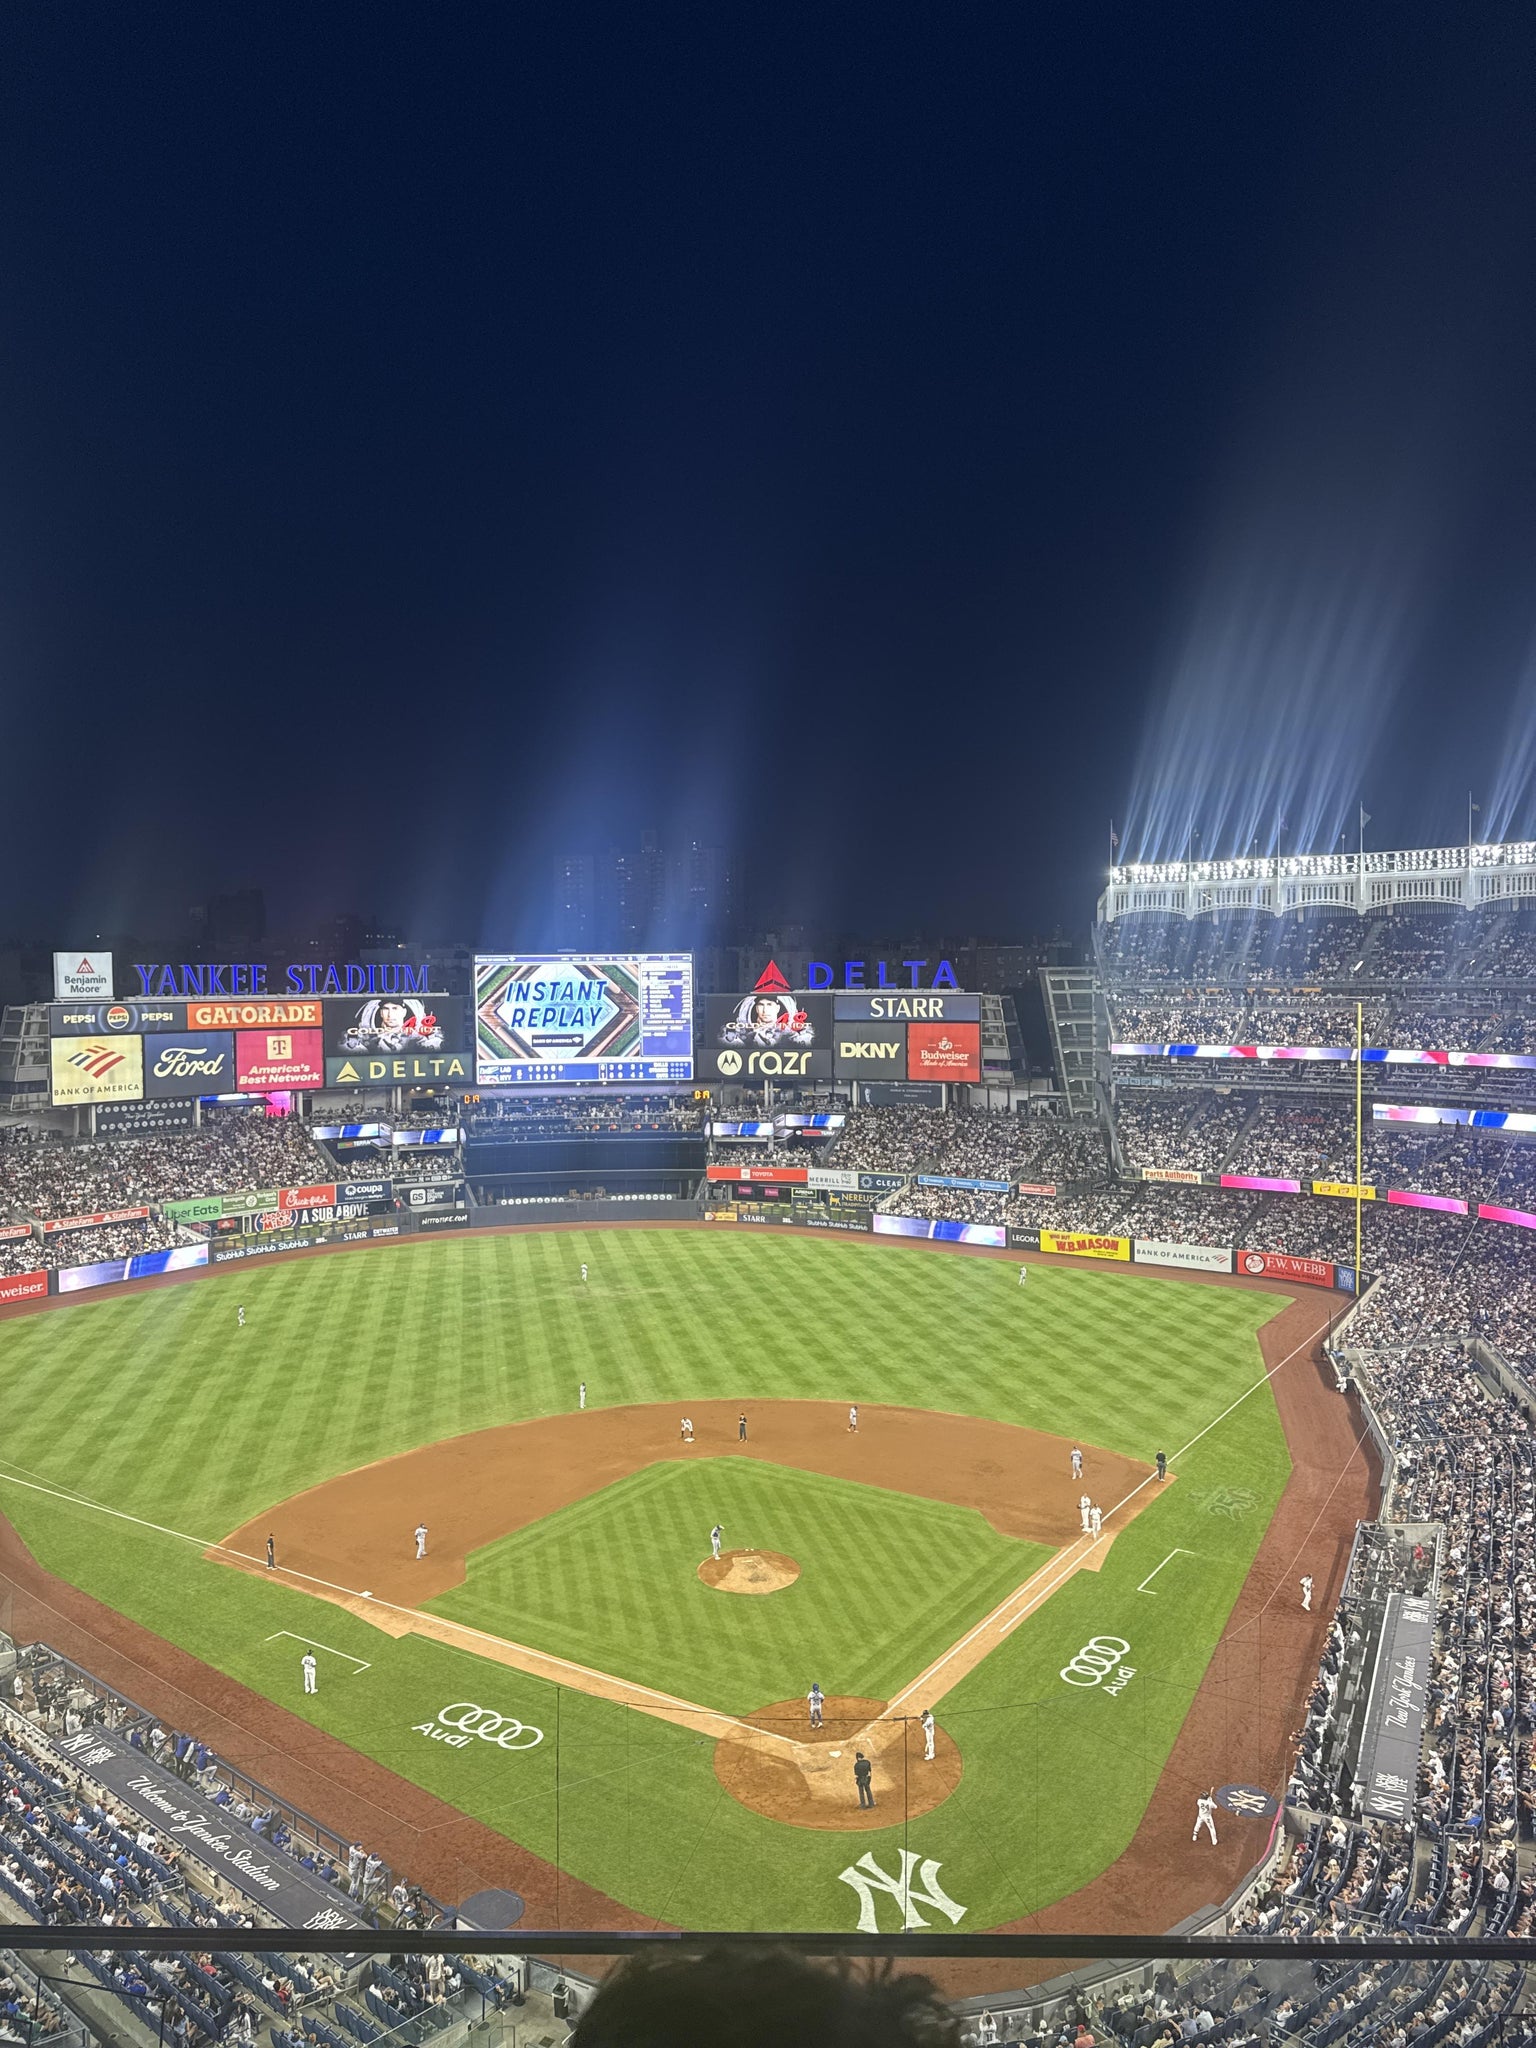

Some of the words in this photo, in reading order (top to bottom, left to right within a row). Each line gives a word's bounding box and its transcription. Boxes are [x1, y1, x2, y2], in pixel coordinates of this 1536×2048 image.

[64, 975, 107, 986] Benjamin
[134, 964, 267, 995] YANKEE
[285, 964, 430, 994] STADIUM
[808, 960, 958, 990] DELTA
[70, 984, 101, 993] Moore
[506, 981, 608, 1002] INSTANT
[196, 1005, 316, 1025] GATORADE
[870, 997, 944, 1018] STARR
[63, 1015, 96, 1024] PEPSI
[141, 1012, 174, 1022] PEPSI
[511, 1007, 603, 1028] REPLAY
[840, 1042, 900, 1059] DKNY
[920, 1050, 970, 1060] Budweiser
[153, 1047, 225, 1078] Ford
[249, 1064, 311, 1074] America's
[369, 1059, 465, 1079] DELTA
[748, 1051, 813, 1075] razr
[239, 1074, 266, 1085] Best
[268, 1072, 321, 1083] Network
[54, 1088, 80, 1096] BANK
[83, 1086, 95, 1094] OF
[97, 1084, 140, 1093] AMERICA
[876, 1179, 902, 1187] CLEAR
[1164, 1171, 1198, 1181] Authority
[357, 1185, 383, 1194] coupa
[413, 1193, 424, 1201] GS
[841, 1193, 874, 1202] NEREUS
[193, 1205, 219, 1216] Eats
[301, 1210, 309, 1224] A
[312, 1207, 333, 1222] SUB
[743, 1214, 766, 1223] STARR
[343, 1231, 367, 1240] STARR
[1012, 1234, 1040, 1244] LEGORA
[246, 1245, 276, 1256] StubHub
[278, 1240, 309, 1251] StubHub
[216, 1250, 245, 1262] StubHub
[1136, 1249, 1159, 1257] BANK
[1172, 1253, 1211, 1262] AMERICA
[1266, 1256, 1288, 1270] F.W.
[1291, 1260, 1327, 1276] WEBB
[1391, 1656, 1423, 1690] Yankees
[1101, 1665, 1138, 1697] Audi
[1388, 1685, 1420, 1712] York
[1384, 1707, 1408, 1728] New
[411, 1722, 474, 1748] Audi
[126, 1775, 177, 1814] Welcome
[170, 1809, 190, 1821] to
[170, 1814, 232, 1853] Yankee
[223, 1849, 280, 1891] Stadium
[838, 1848, 968, 1934] NY
[321, 1907, 348, 1925] NEW
